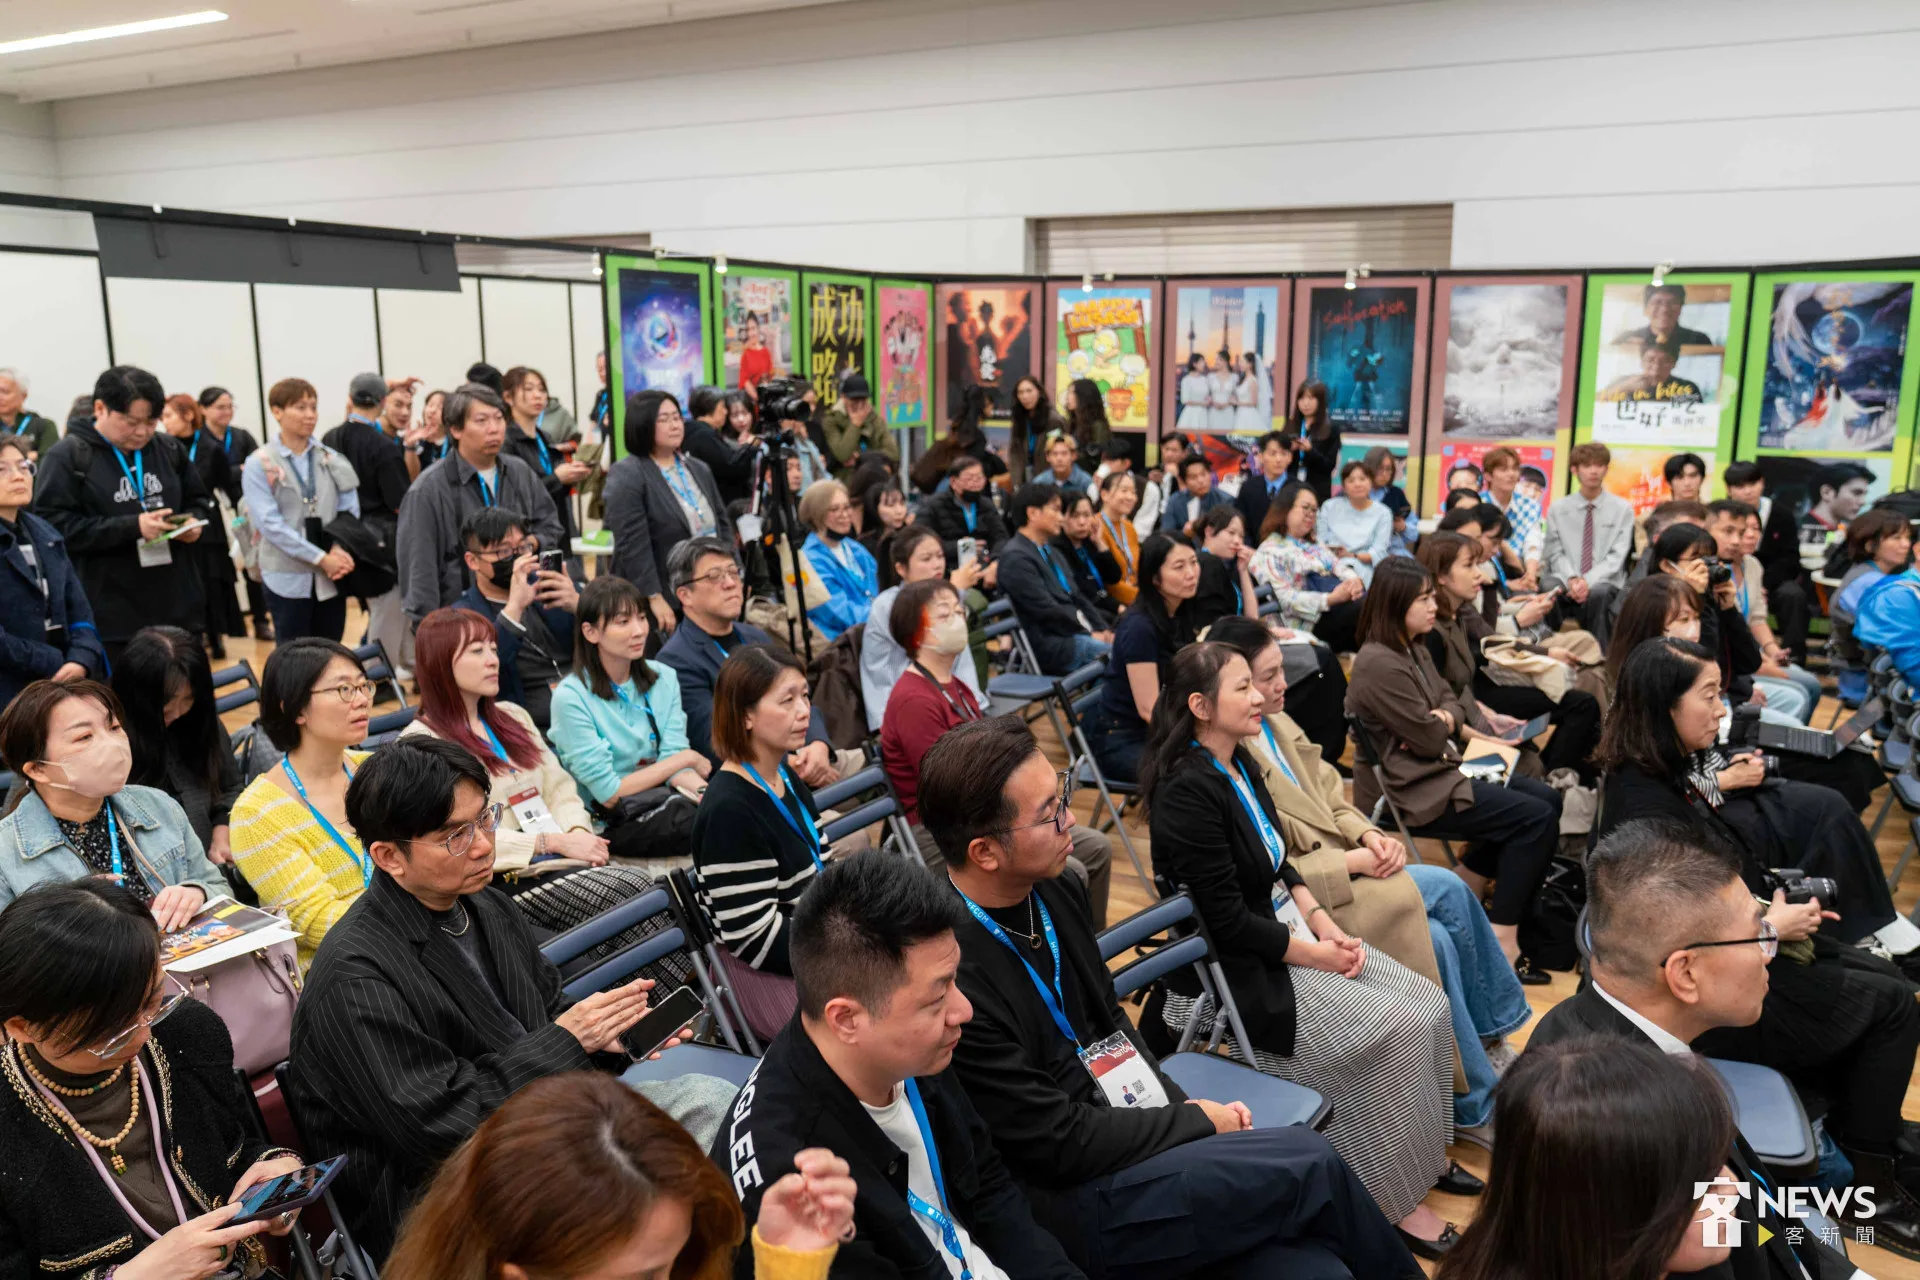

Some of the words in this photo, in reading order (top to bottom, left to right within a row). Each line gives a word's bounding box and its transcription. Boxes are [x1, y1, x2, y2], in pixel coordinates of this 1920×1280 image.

[812, 285, 863, 346] 成功
[1633, 388, 1651, 401] in
[1655, 380, 1693, 402] bites
[964, 898, 989, 924] IFFCOM
